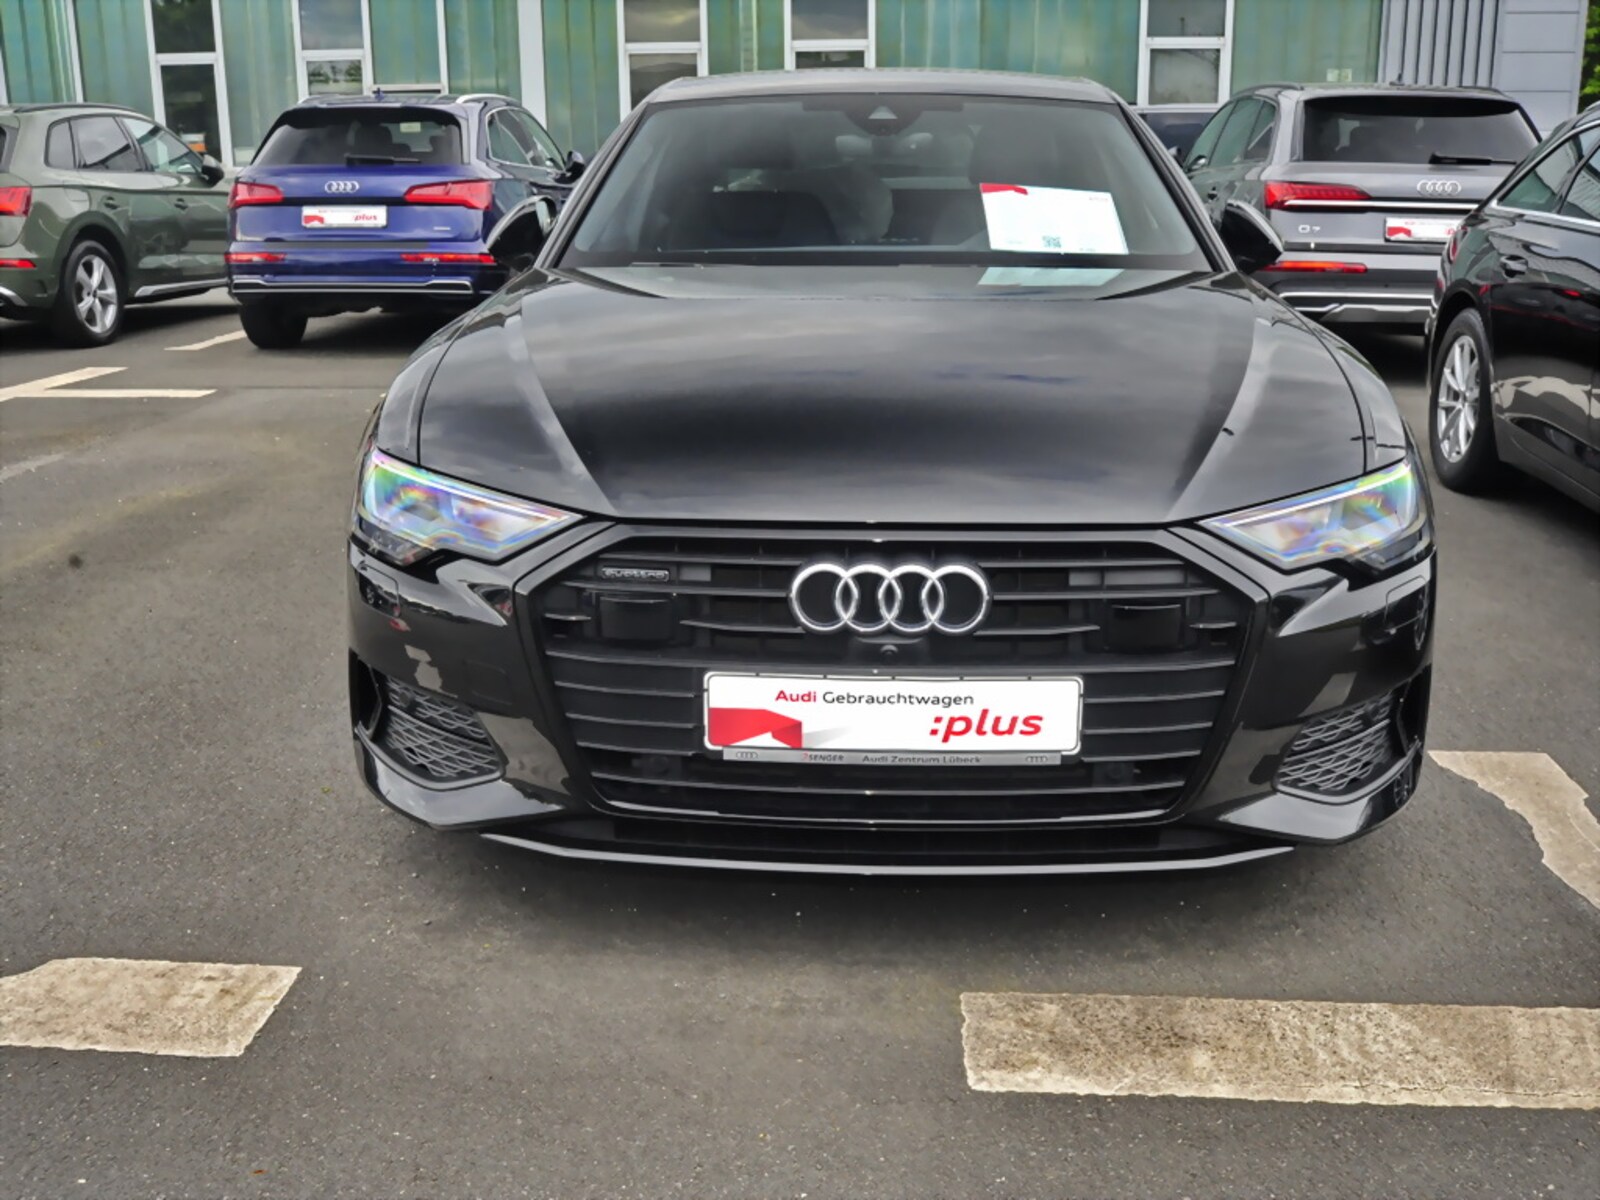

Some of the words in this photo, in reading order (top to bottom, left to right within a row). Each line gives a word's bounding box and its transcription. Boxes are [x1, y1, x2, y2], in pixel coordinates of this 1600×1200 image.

[775, 690, 817, 703] Audi
[822, 691, 974, 708] Gebrauchtwagen
[929, 708, 1043, 743] :plus
[808, 754, 845, 762] SENGER
[862, 755, 889, 763] Audi
[891, 755, 940, 764] Zentrum
[942, 755, 982, 765] Lübeck
